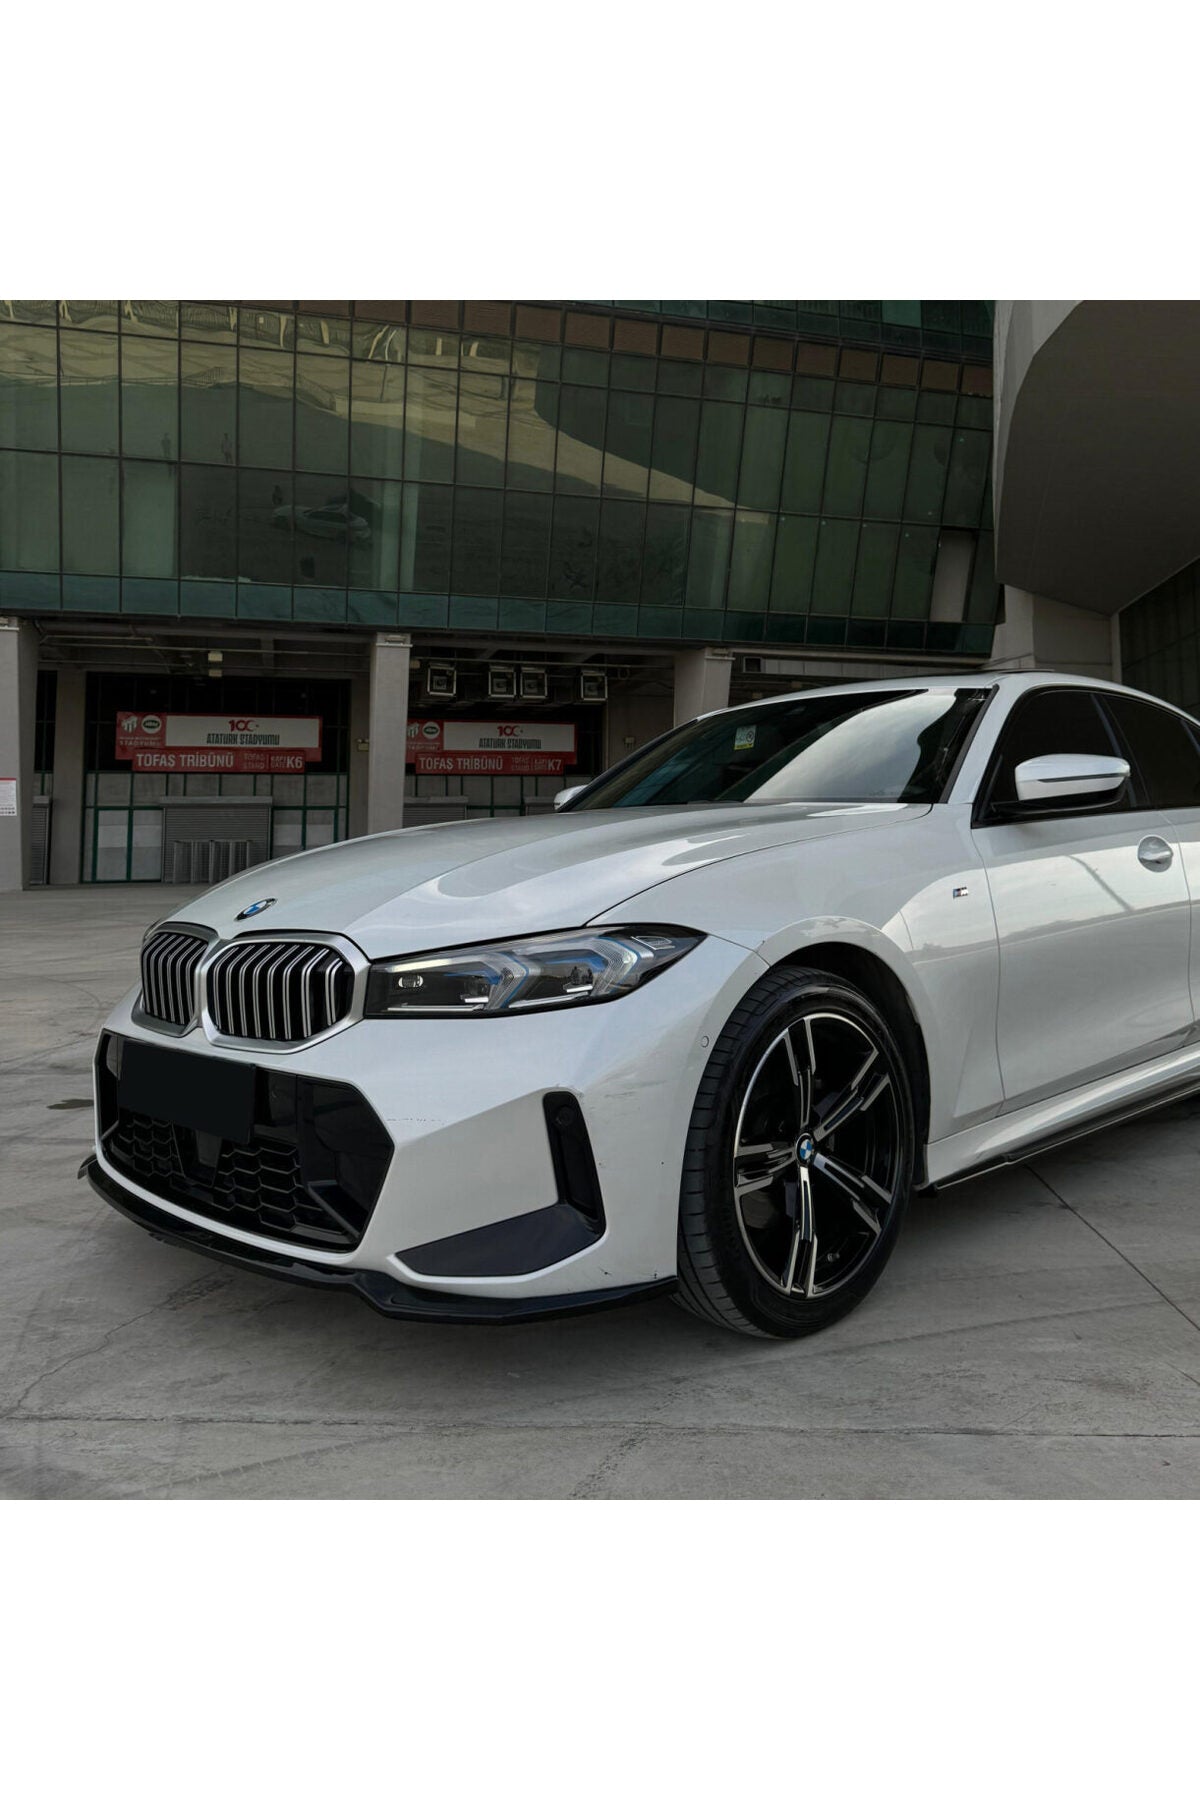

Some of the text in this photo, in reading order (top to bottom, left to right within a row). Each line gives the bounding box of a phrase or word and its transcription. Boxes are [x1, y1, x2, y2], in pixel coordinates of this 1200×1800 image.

[179, 751, 234, 768] TRİBÜNÜ
[287, 756, 303, 769] K6
[456, 755, 503, 770] TRİBÜNÜ
[548, 759, 562, 771] K7
